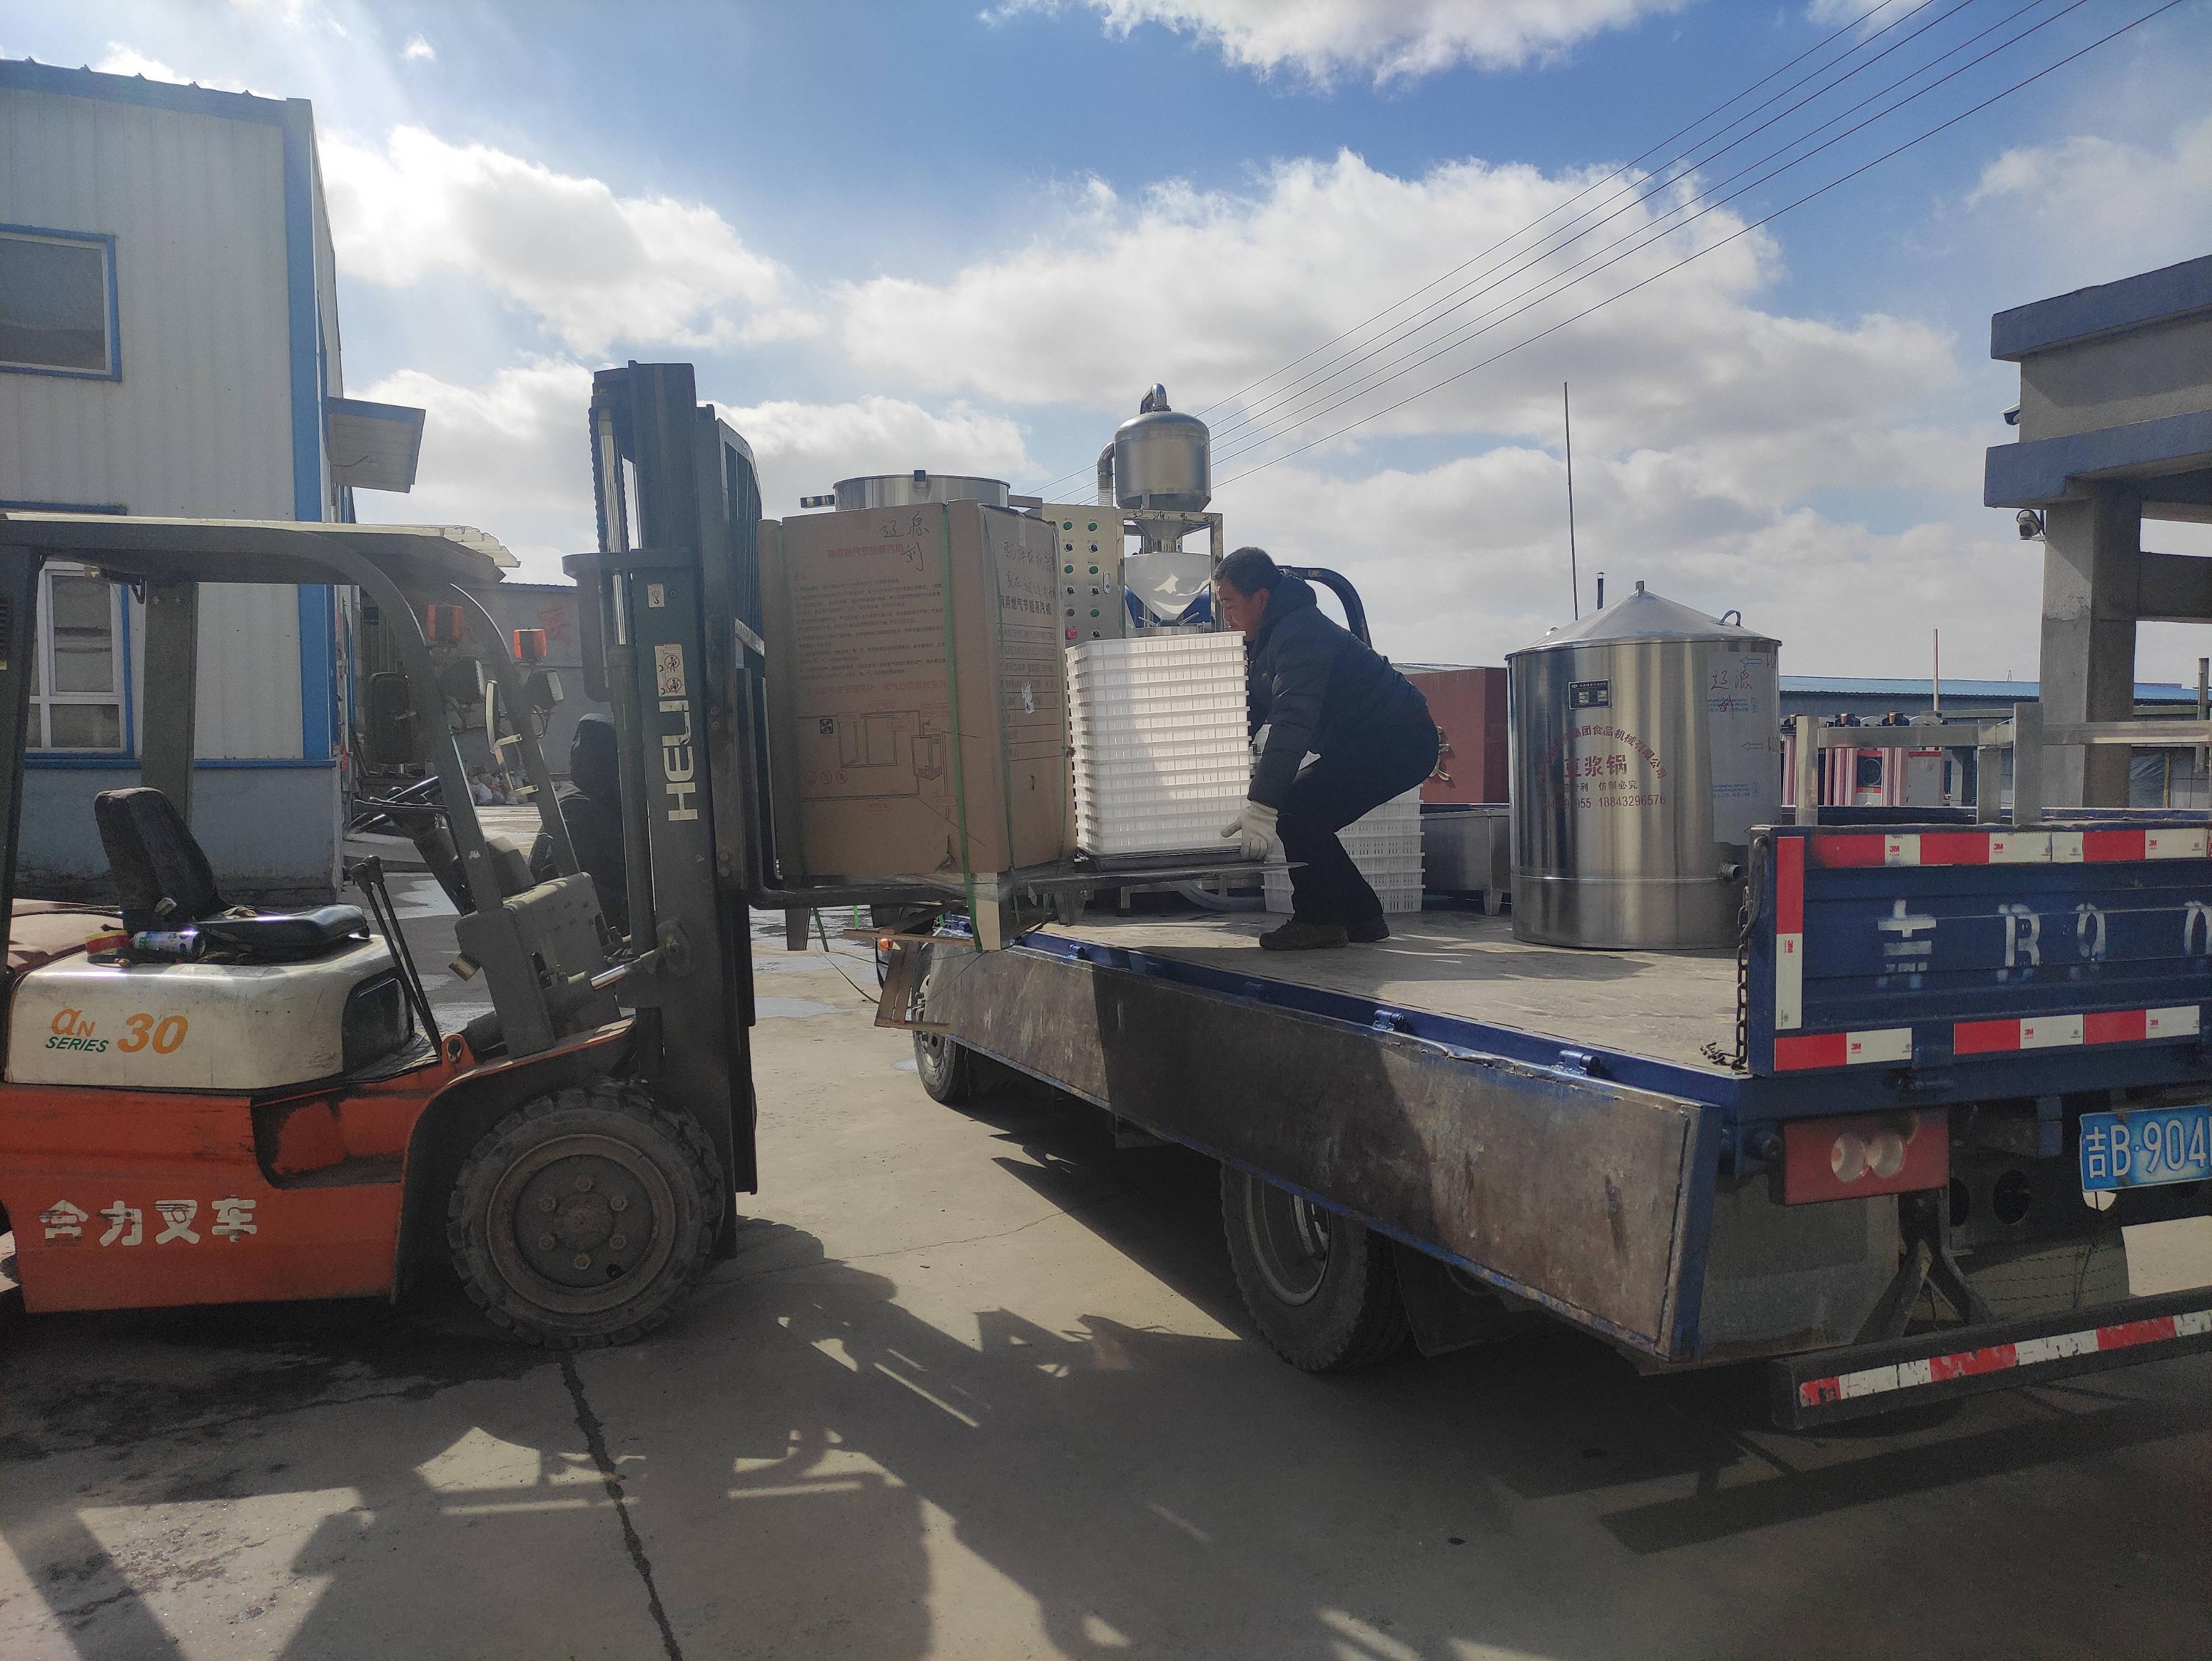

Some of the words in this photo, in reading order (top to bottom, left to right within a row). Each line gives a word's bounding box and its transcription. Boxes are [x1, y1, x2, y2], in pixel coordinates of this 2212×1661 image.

[659, 700, 698, 821] HELI
[1564, 754, 1628, 778] 豆浆锅
[1599, 780, 1638, 792] 仿制必究
[1599, 795, 1666, 808] 18843296576
[45, 1036, 110, 1053] SERIES
[117, 1013, 189, 1055] 30
[2086, 1116, 2212, 1178] 吉B·904
[39, 1195, 257, 1246] 合力叉车
